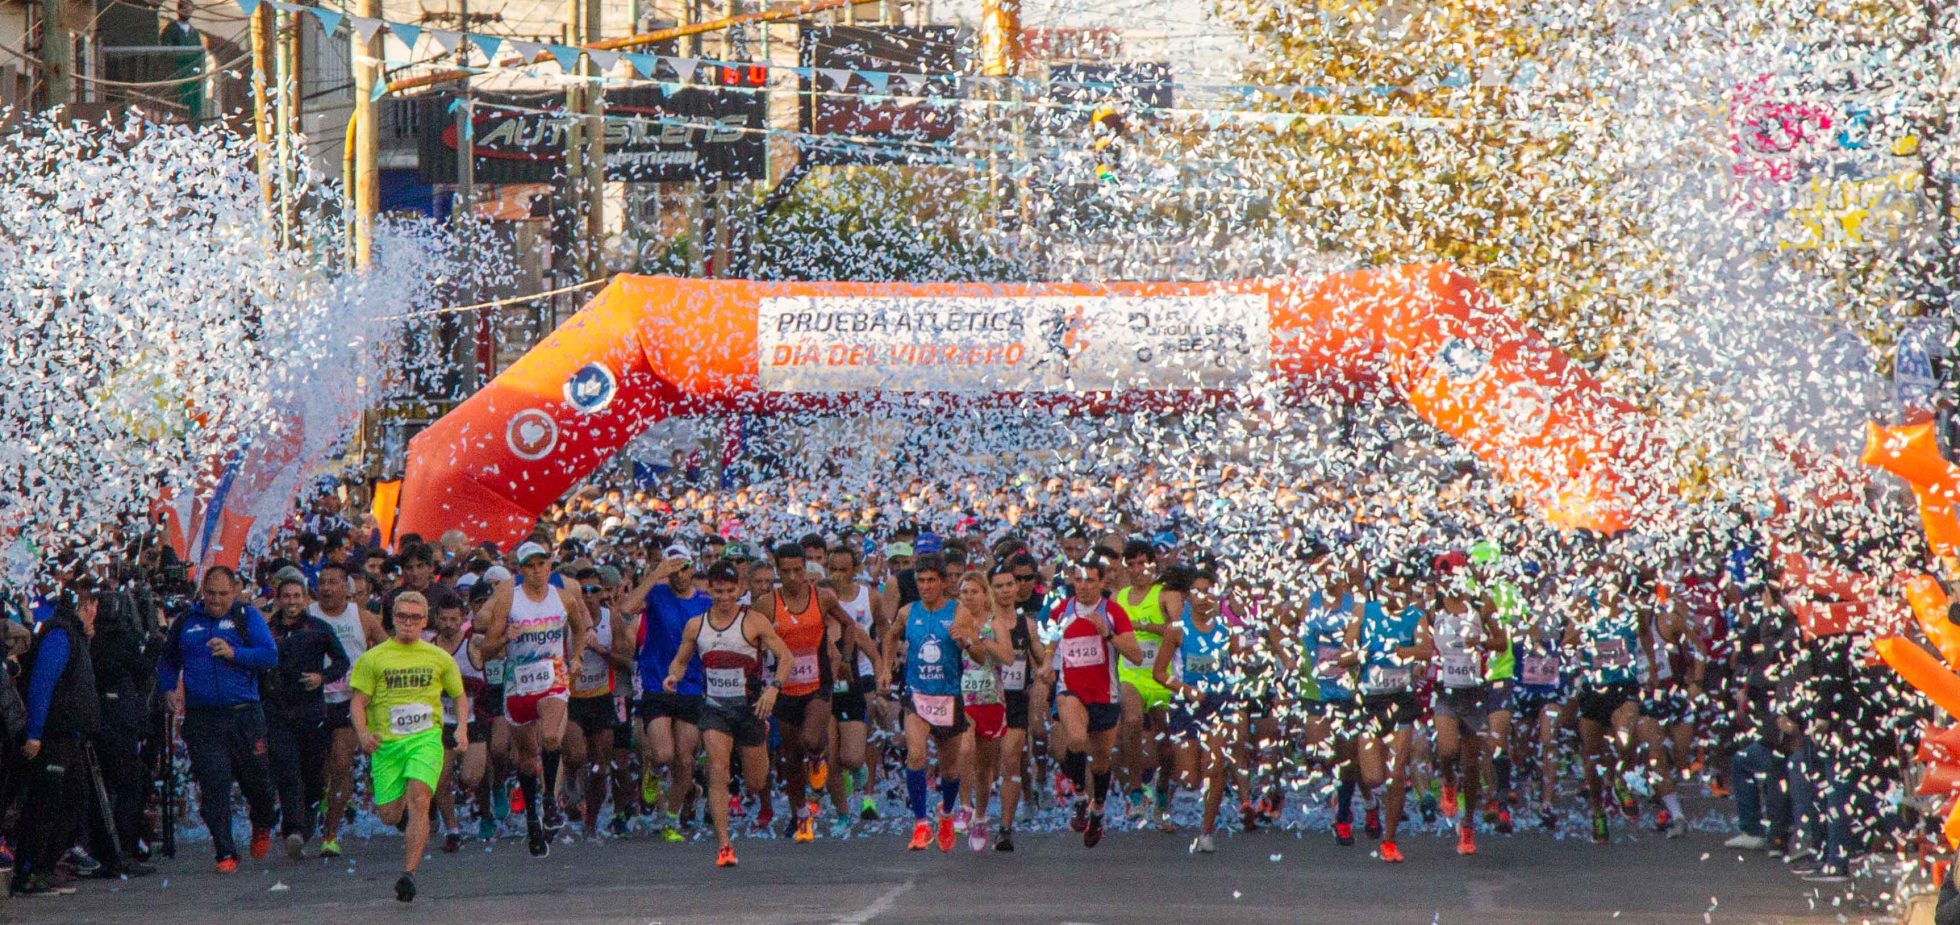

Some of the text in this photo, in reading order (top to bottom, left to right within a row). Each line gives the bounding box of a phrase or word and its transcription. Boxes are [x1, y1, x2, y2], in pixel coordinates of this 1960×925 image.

[477, 114, 748, 146] AUTSILENS
[777, 312, 888, 332] PRUEBA
[827, 343, 878, 366] DEL
[890, 342, 1024, 366] VIDRIERO
[1068, 647, 1098, 658] 4128
[918, 665, 943, 673] YPF
[385, 674, 433, 688] VALDEZ
[520, 671, 550, 684] 0148
[397, 713, 427, 726] 0301
